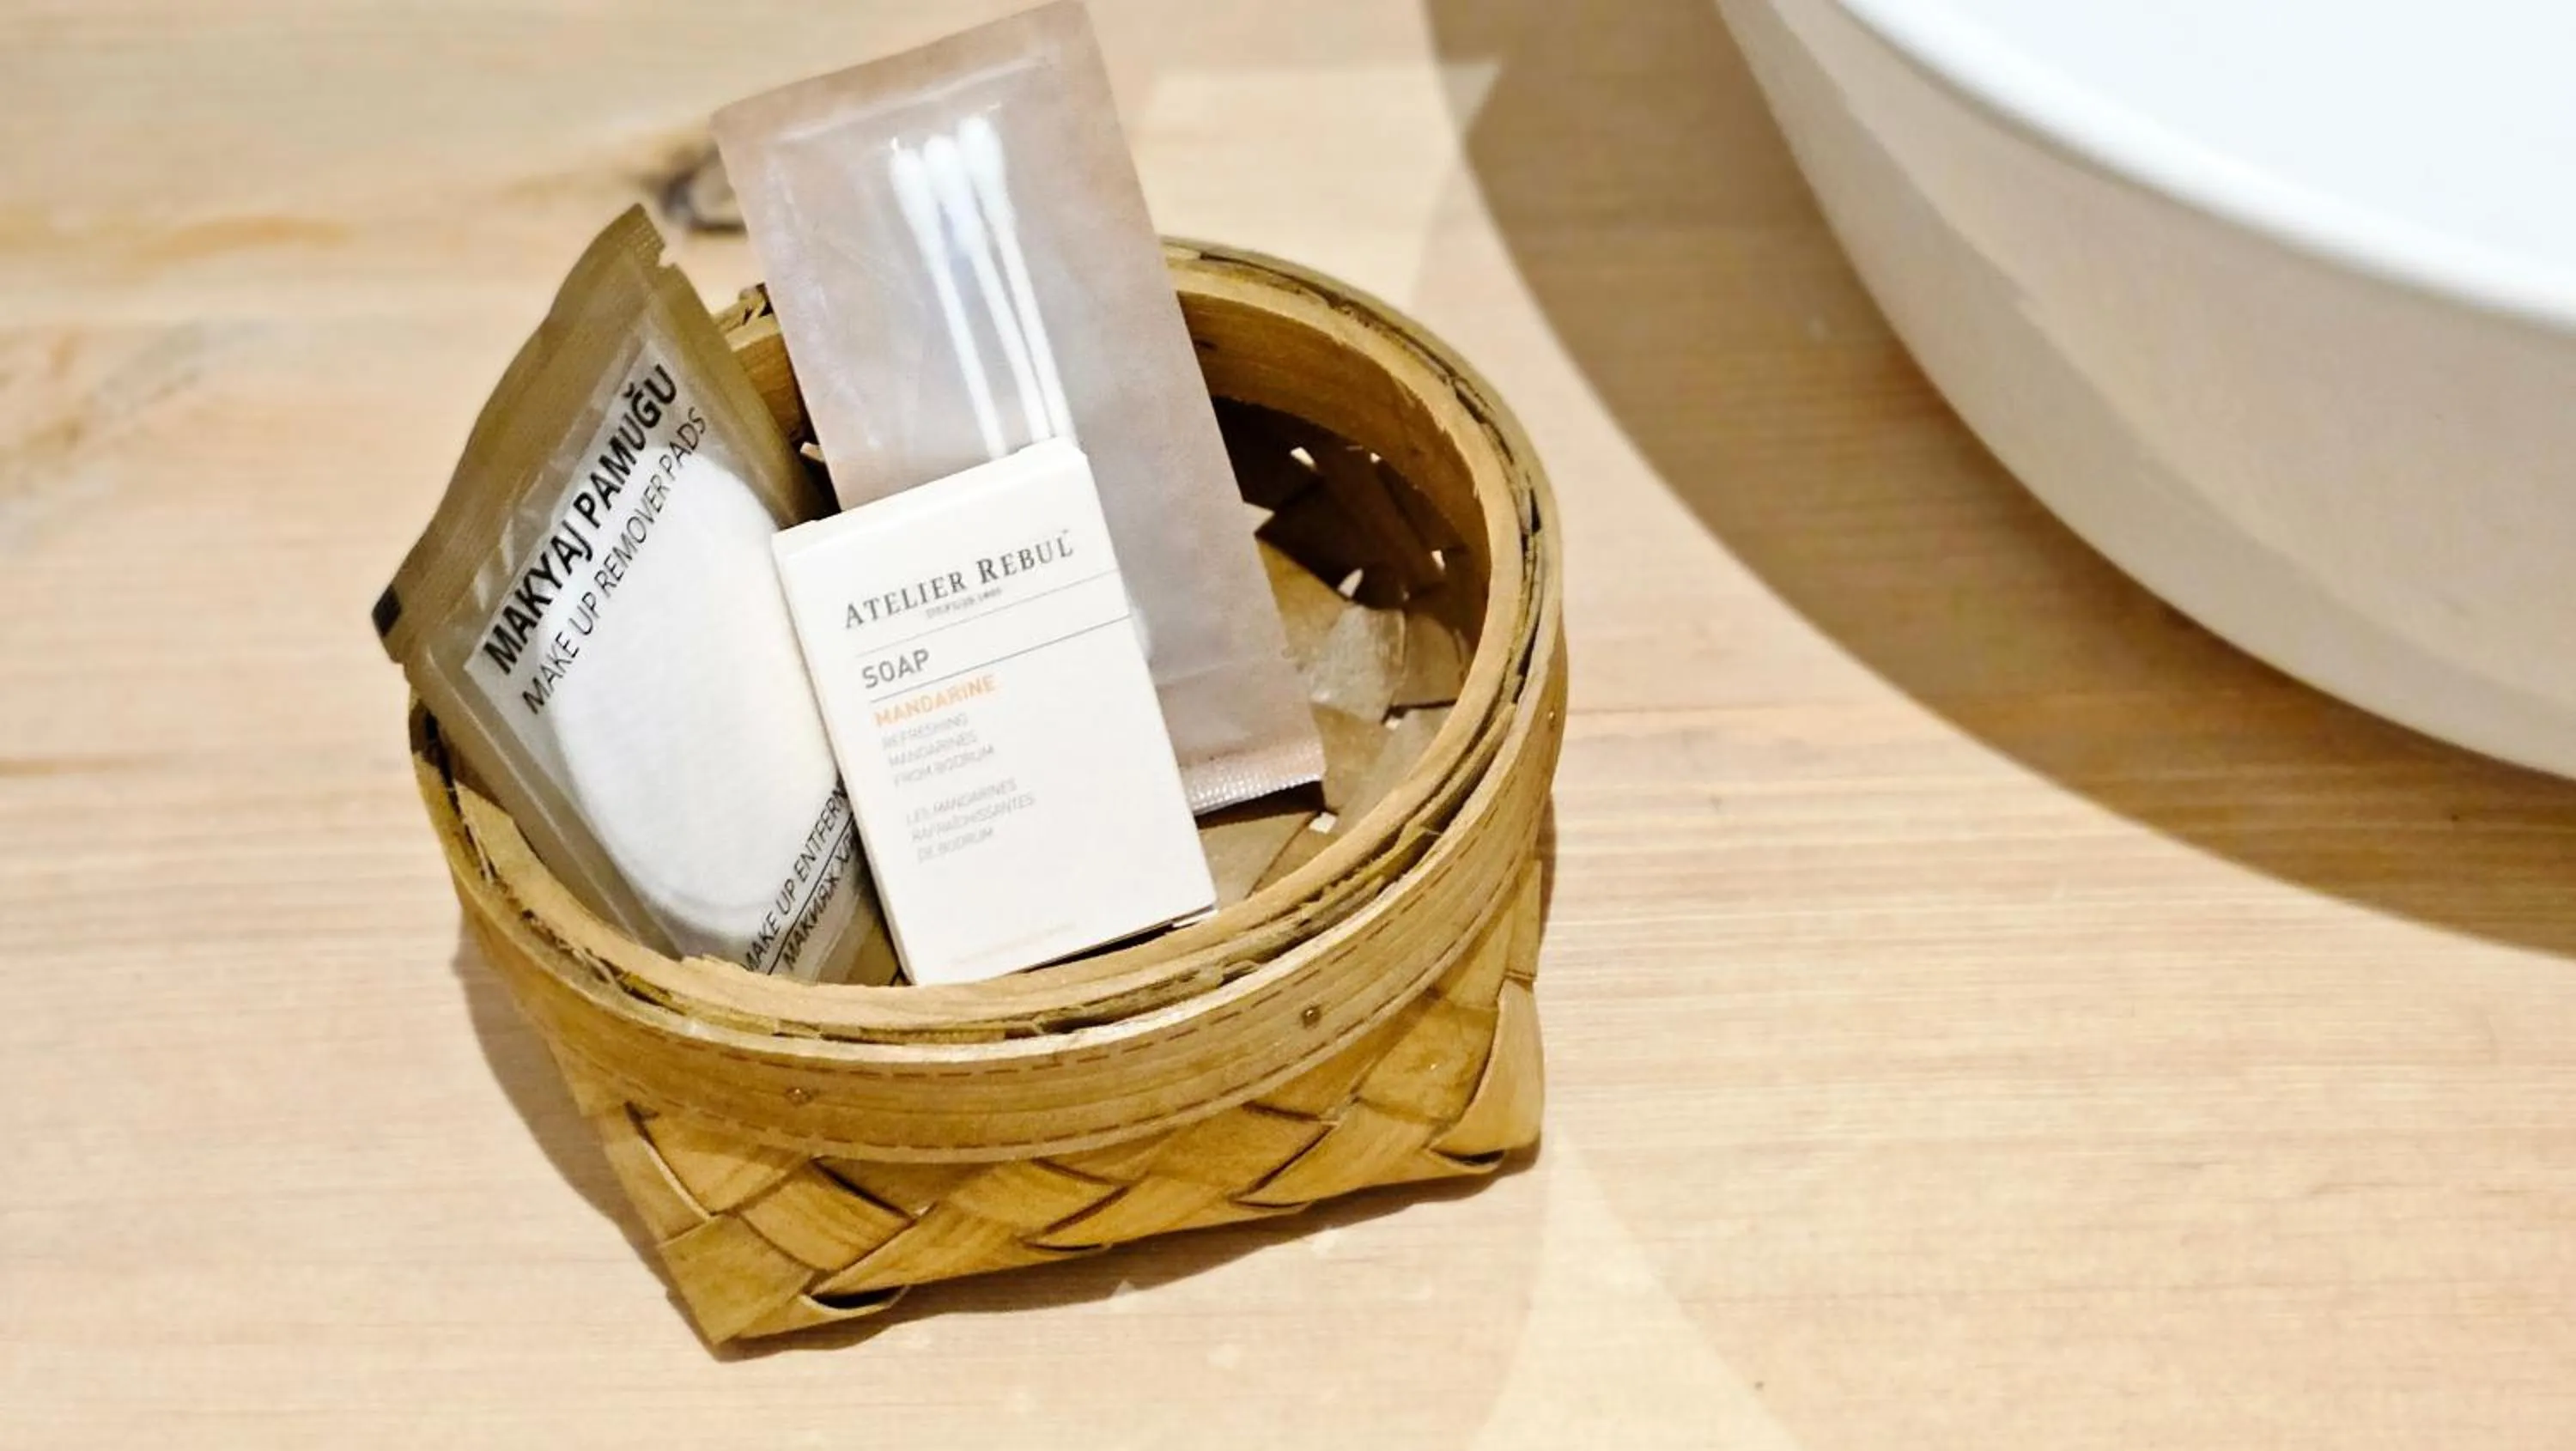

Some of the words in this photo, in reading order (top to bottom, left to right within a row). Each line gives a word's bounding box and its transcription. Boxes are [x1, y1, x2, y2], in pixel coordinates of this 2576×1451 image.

[483, 519, 593, 676] MAKYAJ
[573, 363, 677, 529] PAMUĞU
[521, 630, 580, 714] MAKE
[568, 591, 600, 636] UP
[593, 473, 671, 598] REMOVER
[659, 406, 707, 469] PADS
[846, 571, 968, 628] ATELIER
[976, 532, 1073, 585] REBUL
[861, 648, 930, 689] SOAP
[873, 676, 996, 726] MANDARINE
[775, 878, 796, 915] UP
